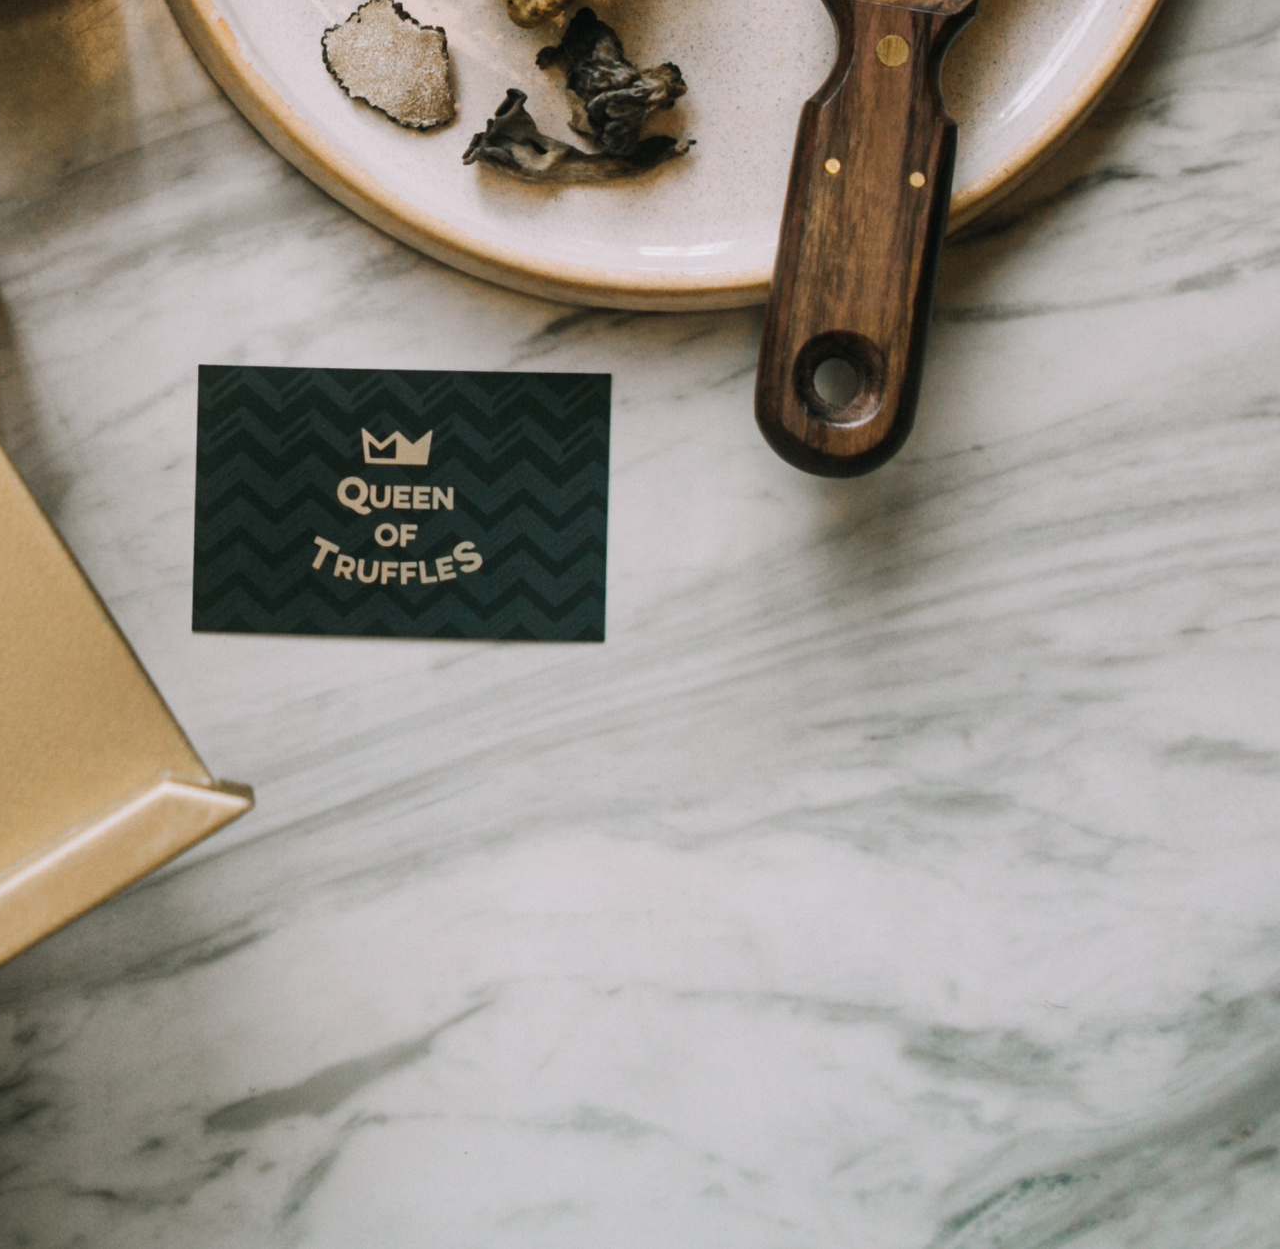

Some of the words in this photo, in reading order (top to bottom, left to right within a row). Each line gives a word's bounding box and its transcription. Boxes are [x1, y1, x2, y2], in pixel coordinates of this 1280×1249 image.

[337, 476, 454, 515] QUEEN
[374, 523, 418, 548] OF
[312, 536, 483, 585] TRUFFLES
